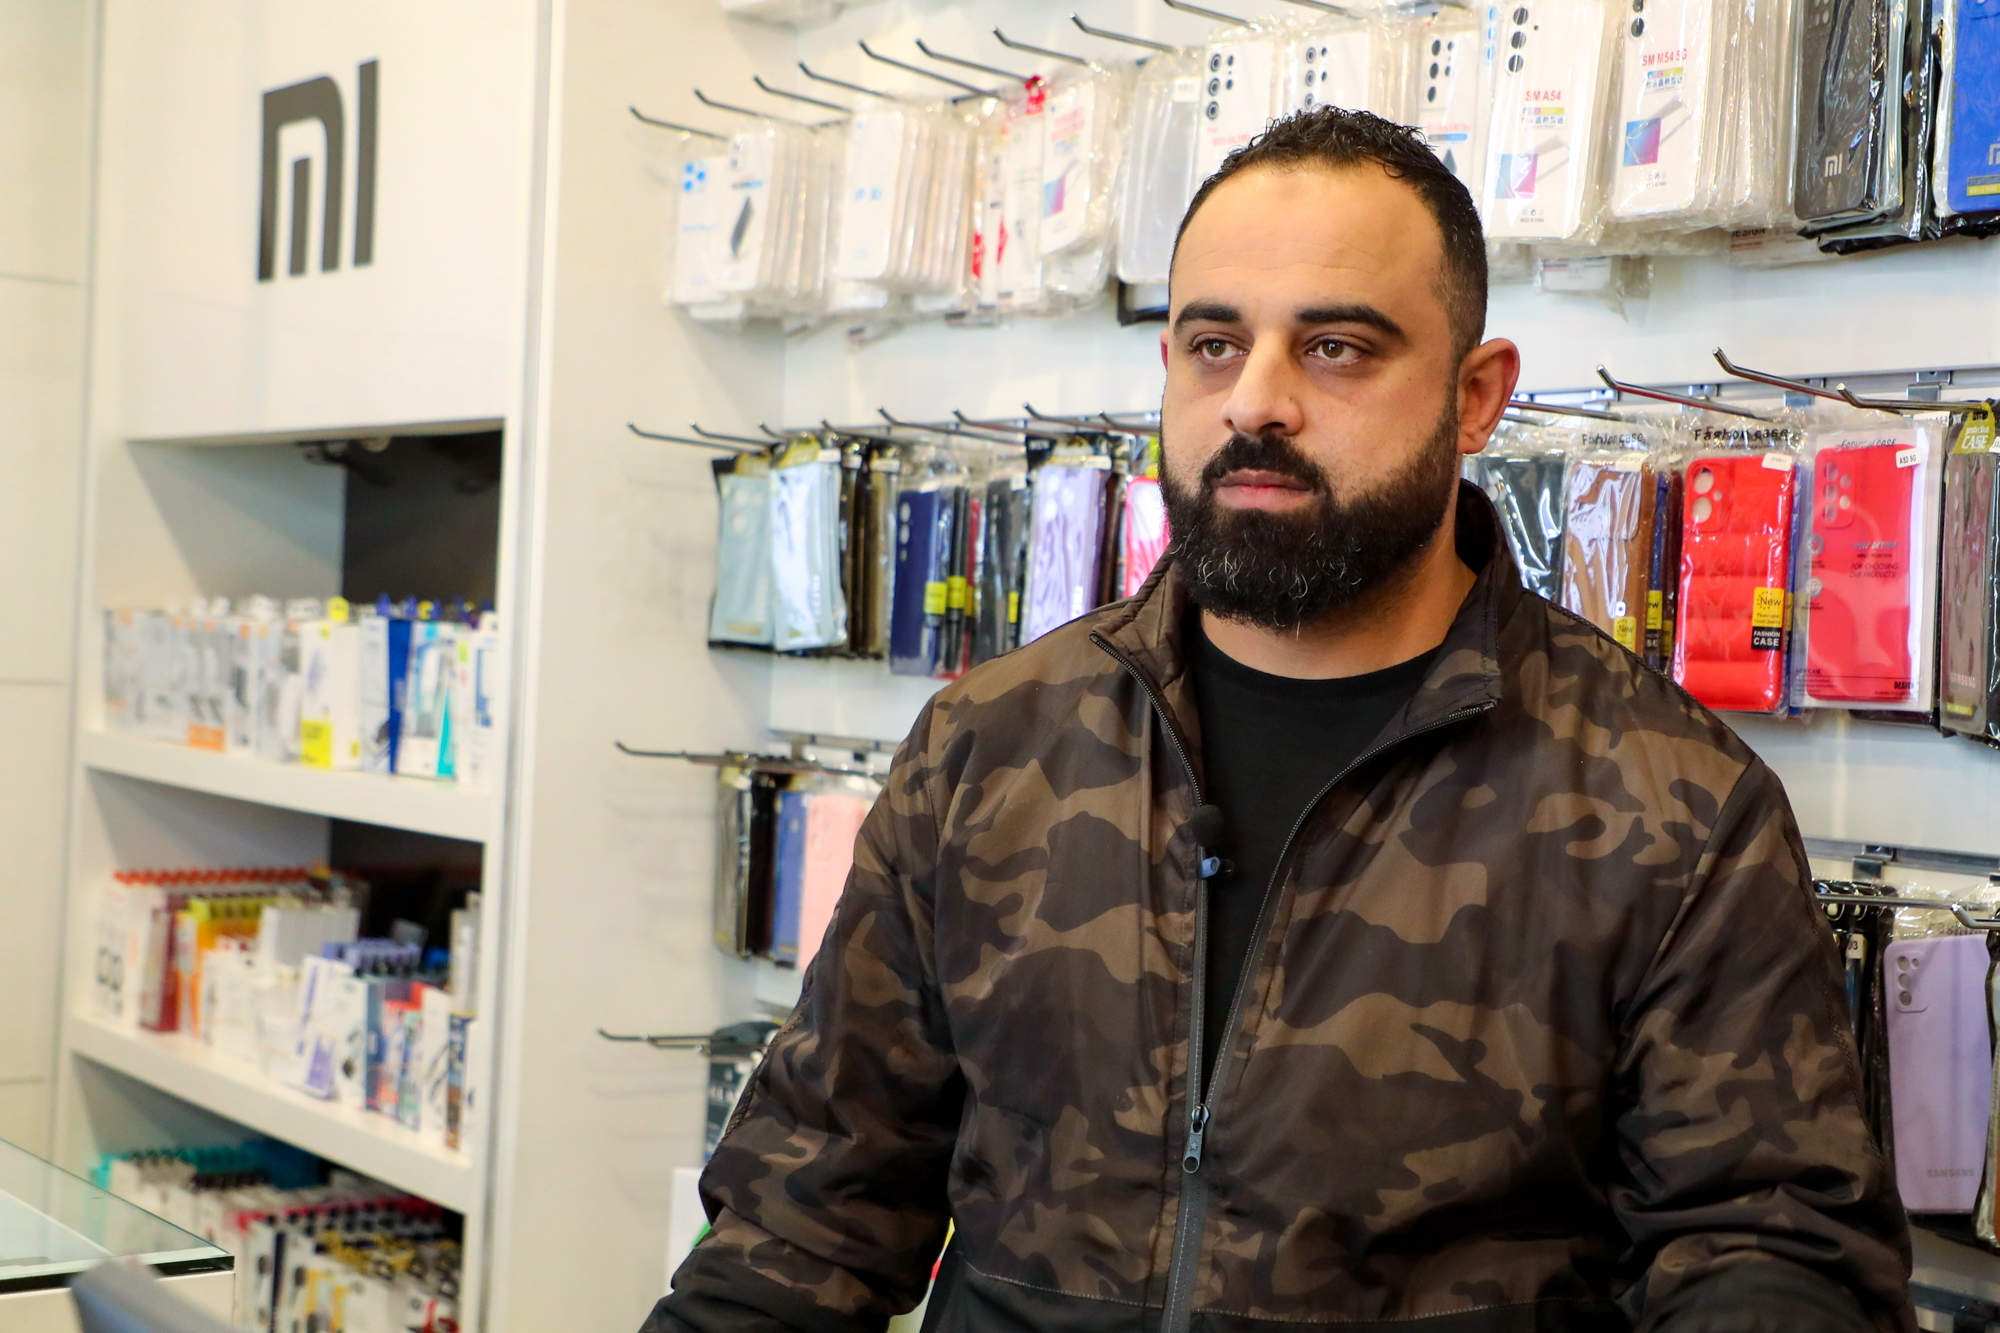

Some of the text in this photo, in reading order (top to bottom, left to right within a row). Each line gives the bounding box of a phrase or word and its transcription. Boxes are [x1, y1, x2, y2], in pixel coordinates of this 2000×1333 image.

[1642, 48, 1688, 67] SM M54 5G
[1525, 90, 1562, 102] SM A54
[1876, 438, 1897, 447] CASE
[1961, 434, 1989, 450] CASE
[1761, 597, 1782, 606] New
[1619, 624, 1634, 634] New
[1753, 637, 1780, 647] CASE
[1950, 671, 1976, 689] SAMSUNG
[1927, 1168, 1975, 1178] SAMSUNG
